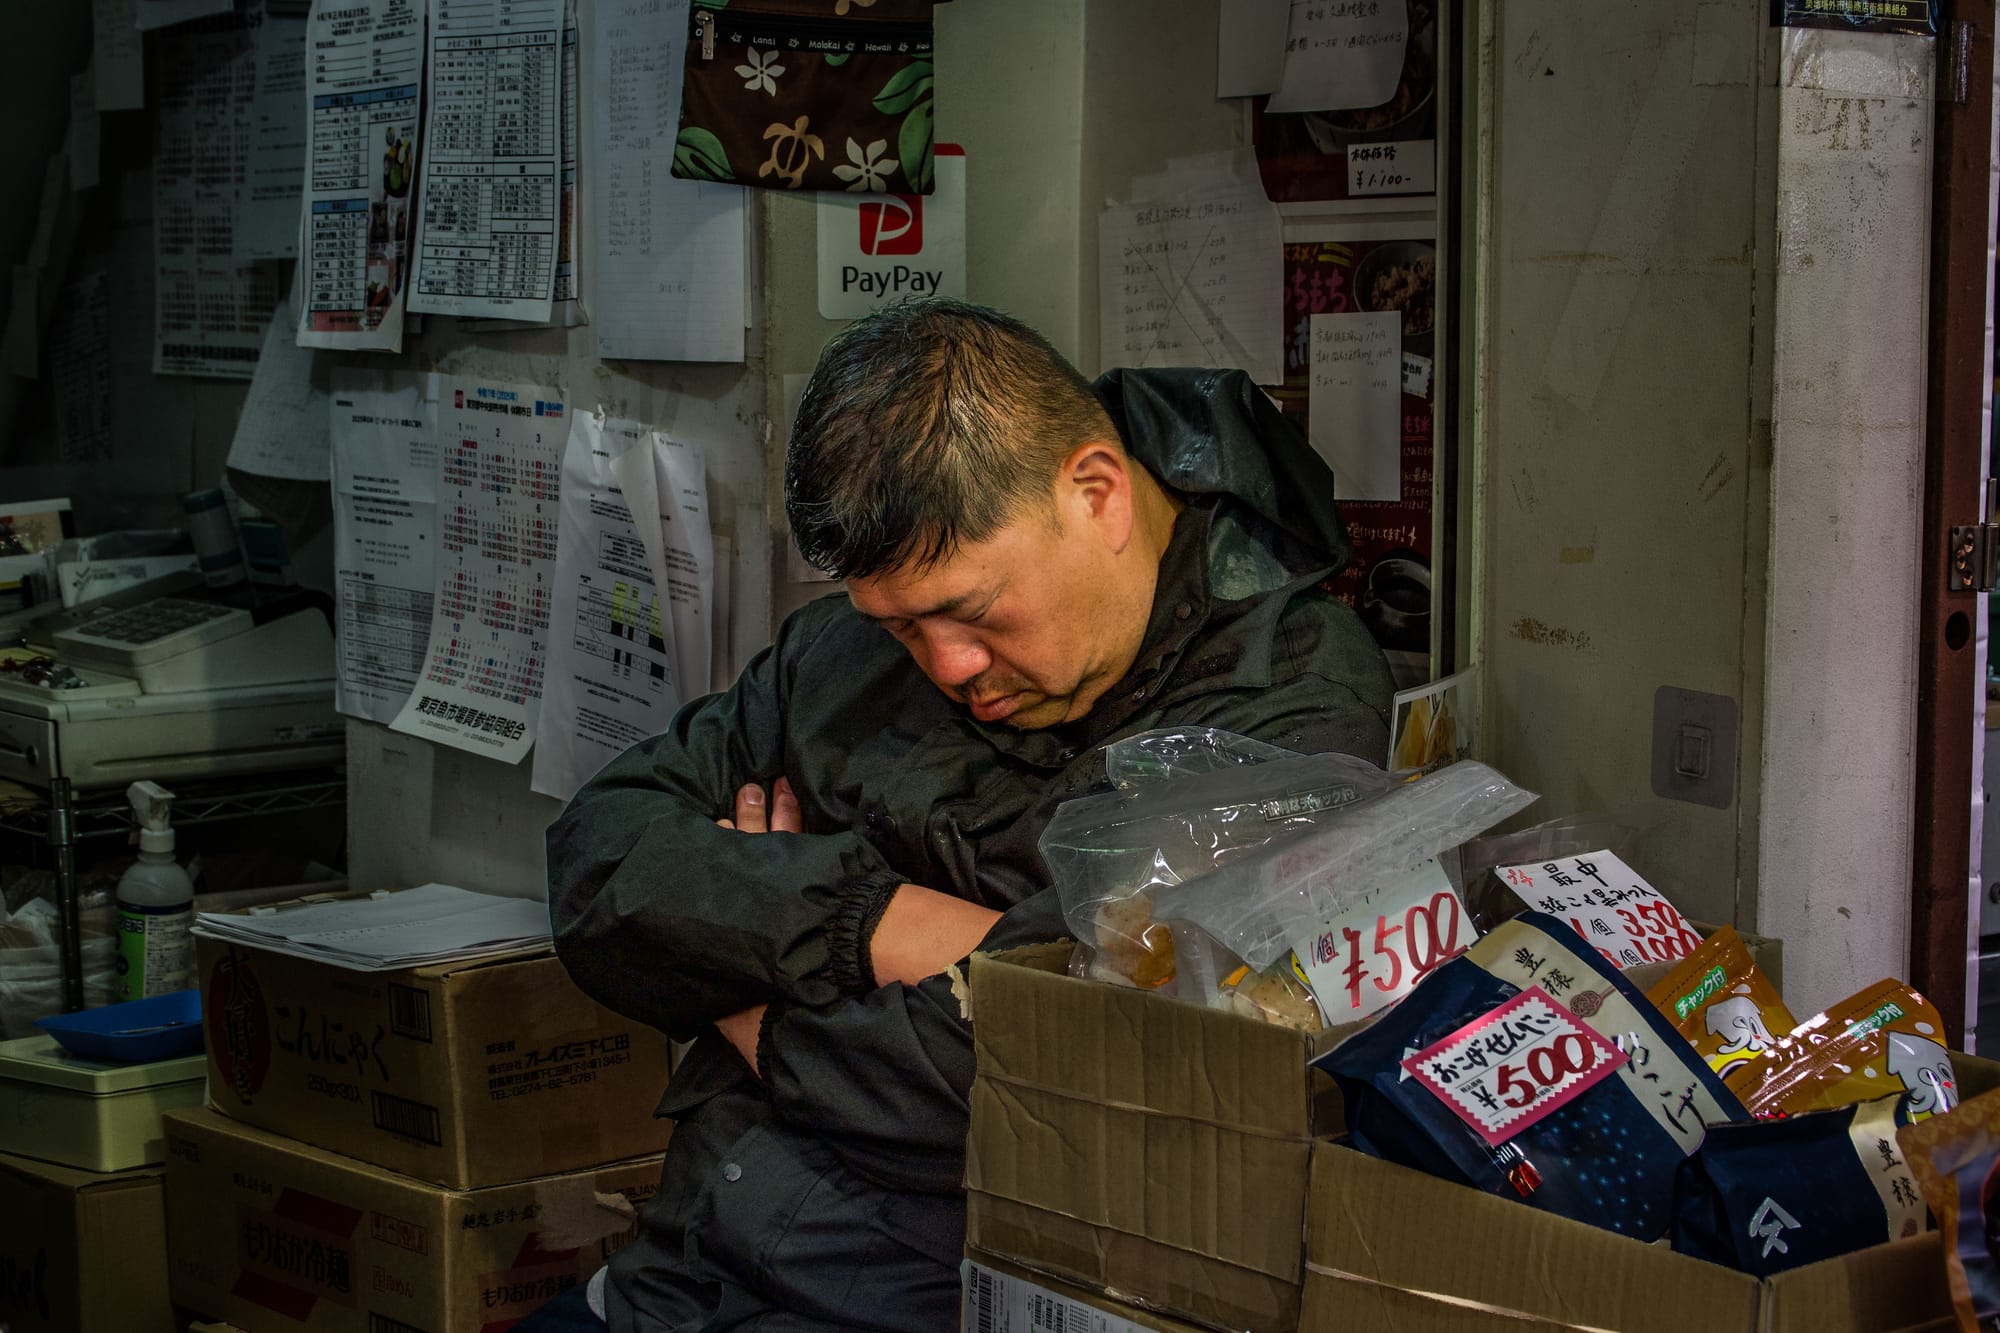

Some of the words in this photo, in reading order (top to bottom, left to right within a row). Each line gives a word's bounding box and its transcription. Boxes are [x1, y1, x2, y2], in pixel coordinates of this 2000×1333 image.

[841, 264, 943, 298] PayPay
[415, 695, 527, 742] 東京魚市場買参協同組合
[1541, 857, 1610, 888] 最中
[1309, 930, 1340, 968] 1個
[1341, 891, 1460, 1009] ¥500
[1676, 966, 1727, 1018] チャック付
[274, 1006, 391, 1083] こんにゃく
[1431, 1012, 1558, 1084] おこげせんべい
[1471, 1032, 1596, 1111] ¥500
[242, 1217, 352, 1294] もりおか冷麺
